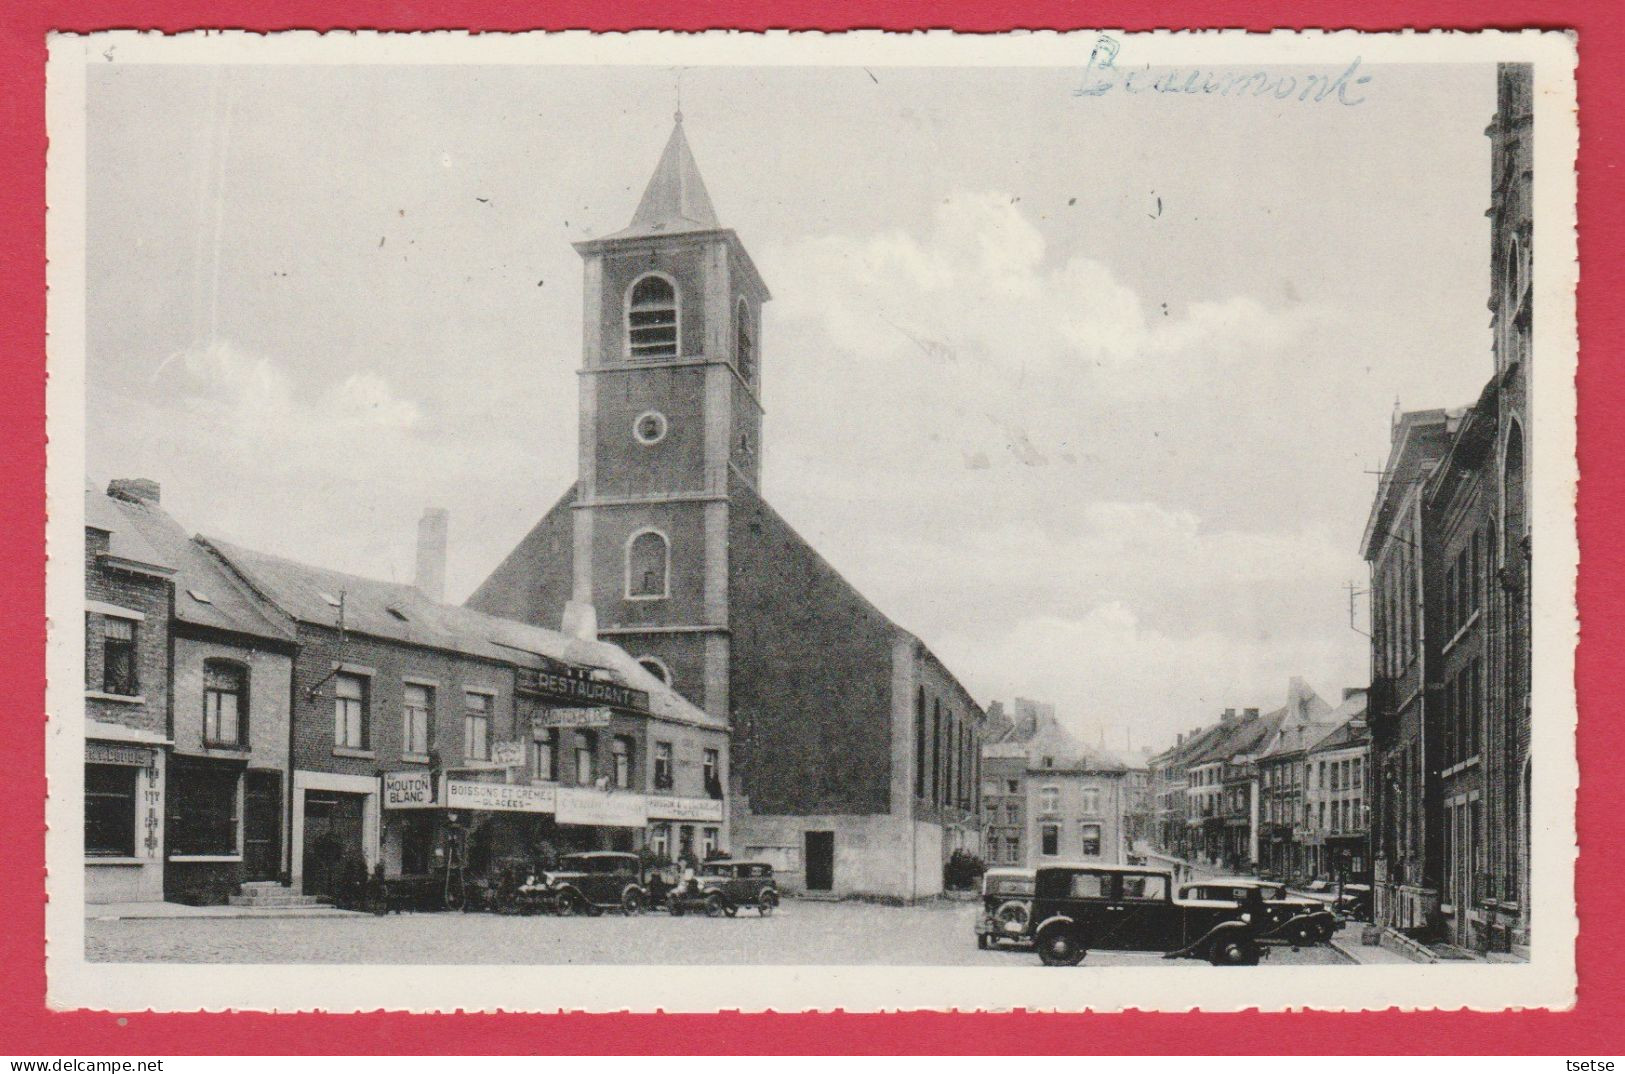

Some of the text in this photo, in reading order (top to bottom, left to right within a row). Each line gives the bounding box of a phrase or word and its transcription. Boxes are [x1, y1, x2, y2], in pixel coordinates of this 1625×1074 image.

[1072, 34, 1372, 106] Beaumont
[538, 673, 630, 705] RESTAURANT
[387, 779, 429, 792] MOUTON
[450, 784, 498, 798] BOISSONS
[501, 788, 513, 799] ET
[390, 791, 424, 803] BLANC
